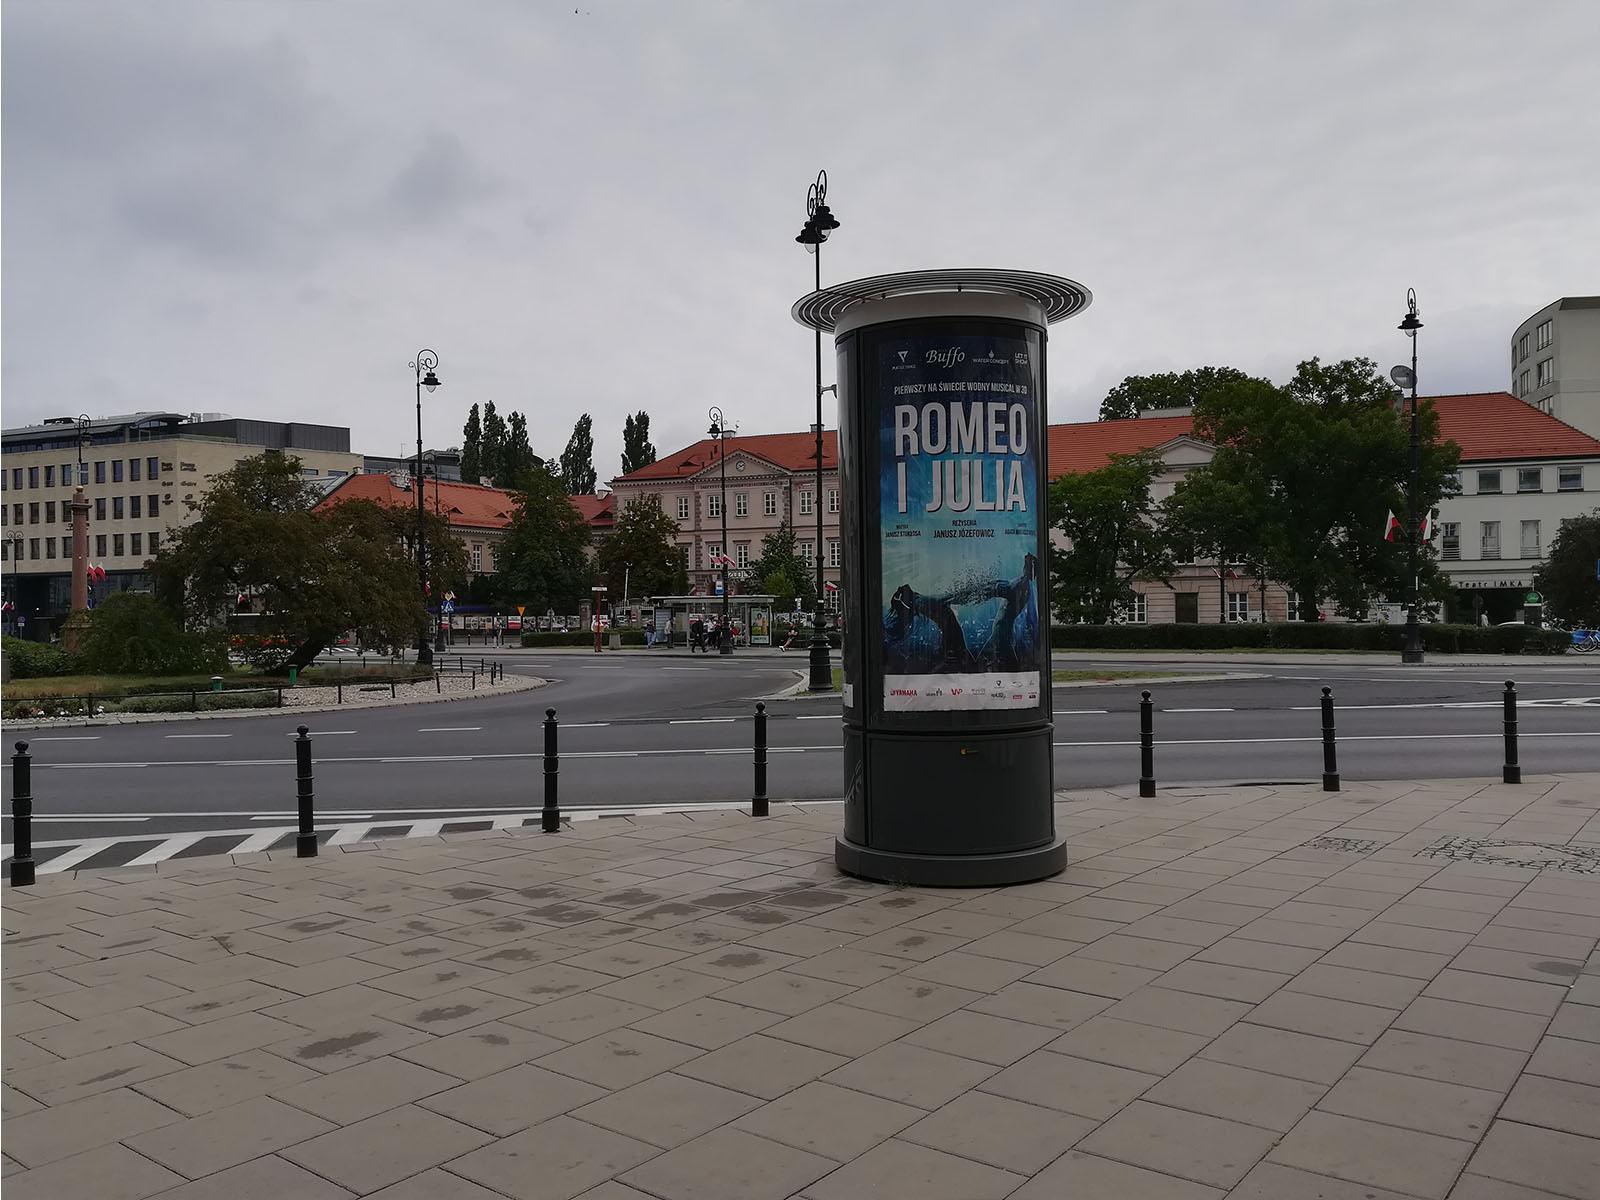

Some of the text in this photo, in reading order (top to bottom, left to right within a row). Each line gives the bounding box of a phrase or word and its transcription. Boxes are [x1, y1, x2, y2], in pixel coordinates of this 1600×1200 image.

[926, 347, 965, 368] Buffo
[894, 383, 926, 395] PIERWSZY
[928, 383, 937, 392] NA
[939, 381, 966, 392] ŚWIECIE
[967, 382, 990, 392] WODNY
[991, 383, 1015, 393] MUSICAL
[895, 402, 1027, 456] ROMEO
[897, 459, 1027, 513] I JULIA
[933, 529, 957, 538] JANUSZ
[958, 528, 995, 538] JÓZEFOWICZ
[1494, 580, 1523, 588] IMKA
[896, 689, 918, 697] YAMAHA
